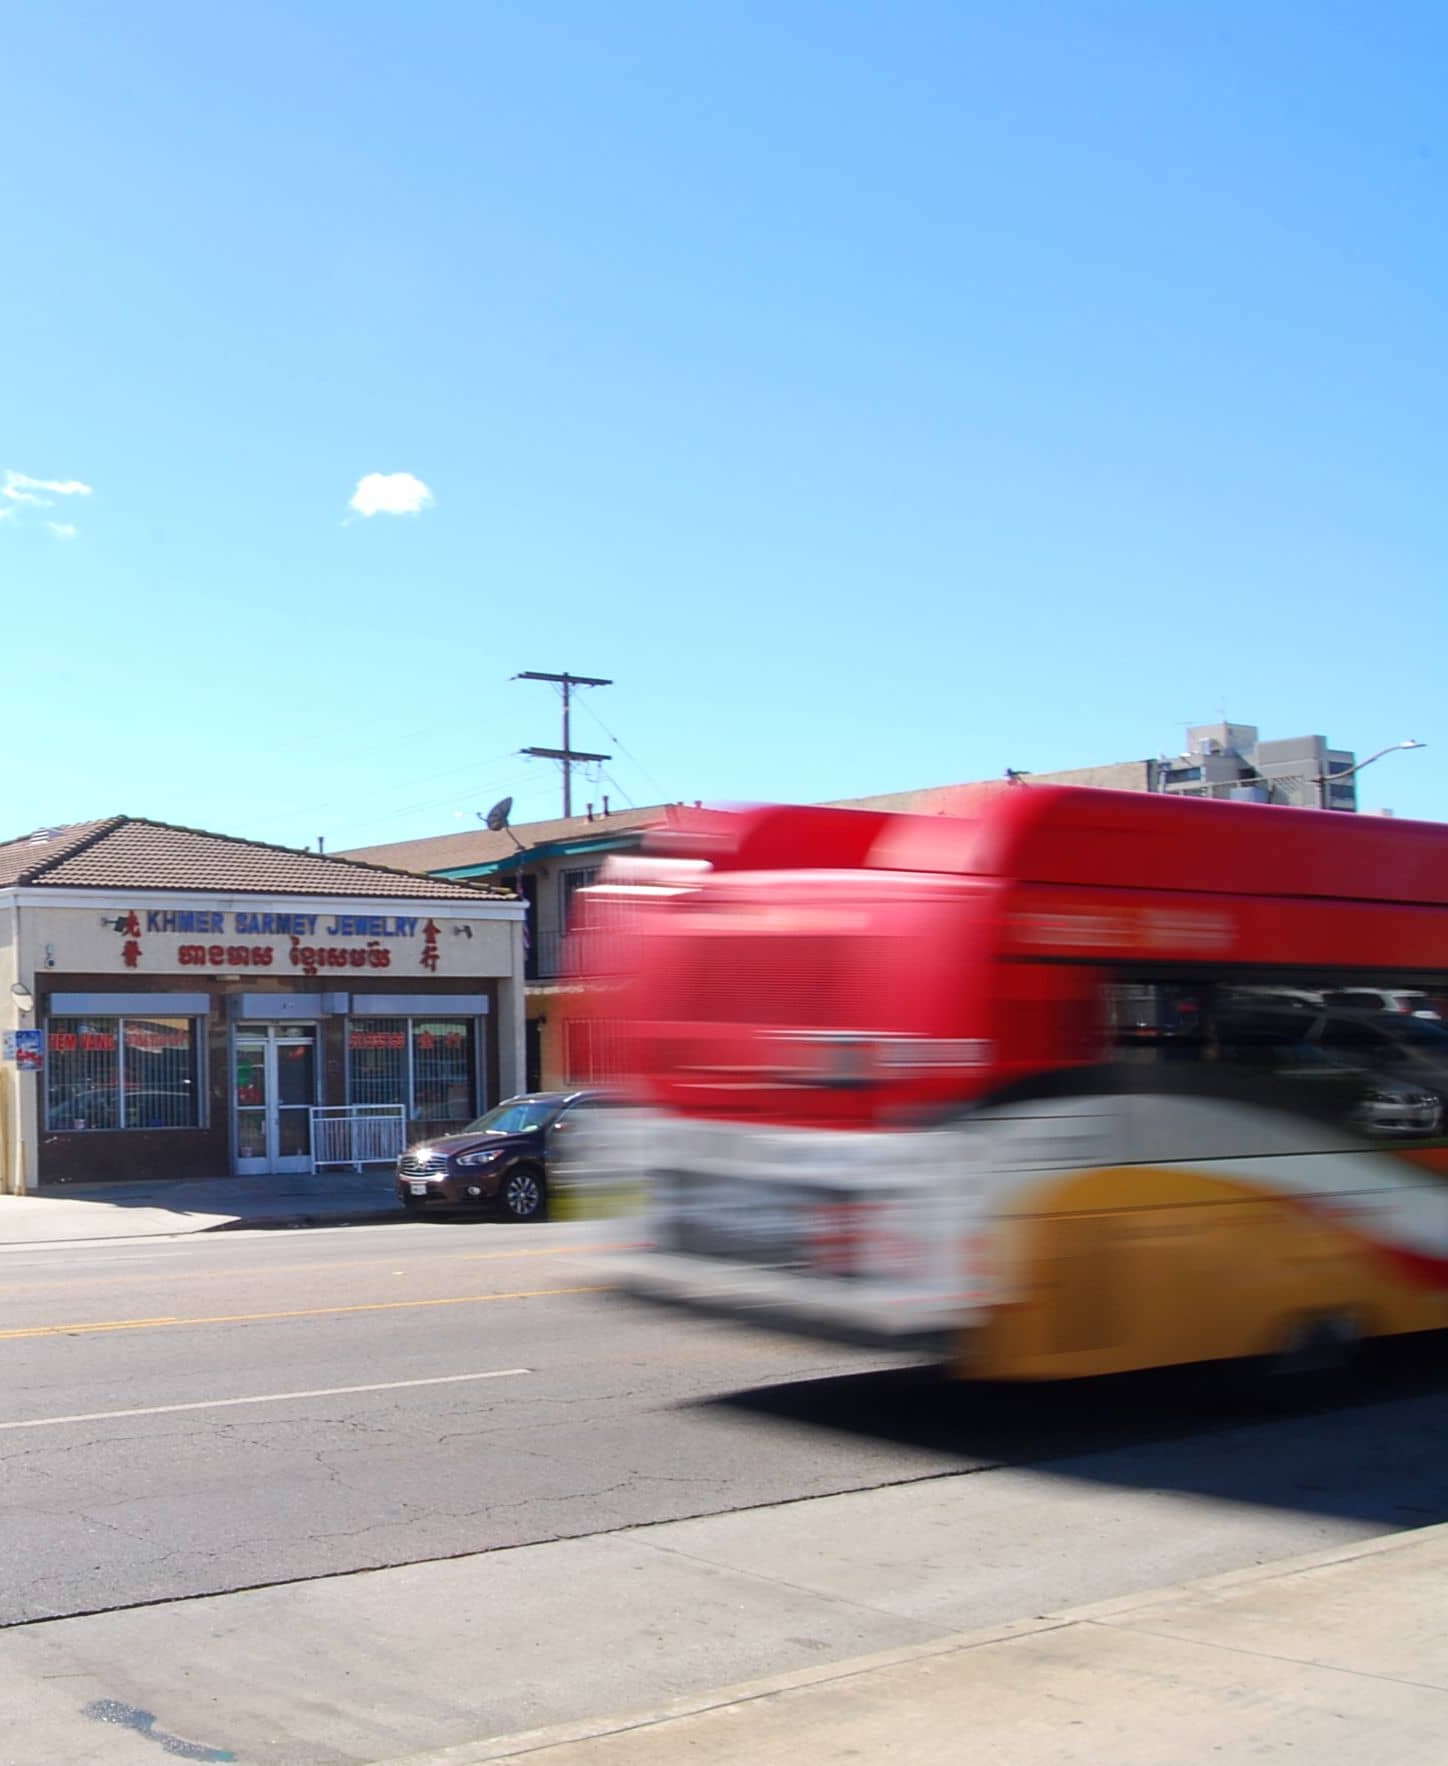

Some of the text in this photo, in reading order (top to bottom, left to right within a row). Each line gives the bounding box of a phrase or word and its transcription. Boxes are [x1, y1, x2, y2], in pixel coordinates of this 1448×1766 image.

[146, 910, 419, 938] KHMER SARMEY JEWELRY
